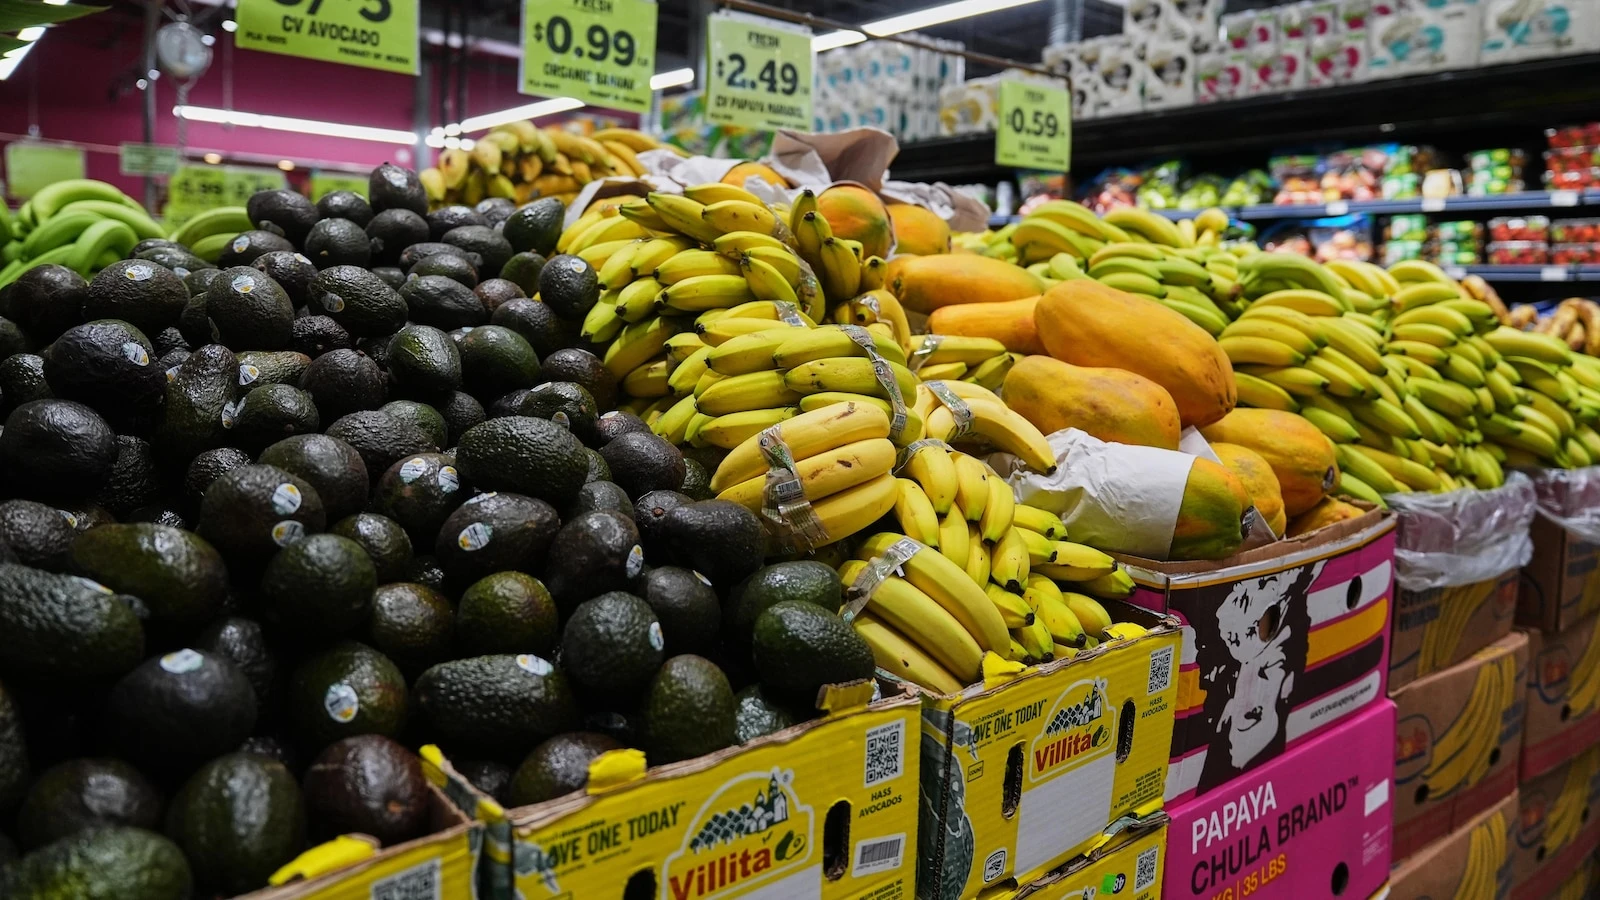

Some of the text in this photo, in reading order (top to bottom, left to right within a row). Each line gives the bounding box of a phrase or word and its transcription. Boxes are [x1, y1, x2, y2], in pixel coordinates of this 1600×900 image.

[281, 15, 380, 47] CV AVOCADO
[534, 16, 635, 67] $0.99
[747, 31, 779, 48] FRESH
[544, 62, 591, 83] ORGANIC
[717, 53, 798, 96] $2.49
[1141, 702, 1168, 719] AVOCADOS
[1150, 696, 1163, 707] HASS
[993, 712, 1013, 735] ONE
[1035, 732, 1092, 772] Villita
[859, 794, 903, 819] AVOCADOS
[870, 787, 892, 802] HASS
[1192, 780, 1277, 855] PAPAYA
[587, 823, 622, 855] ONE
[669, 848, 771, 900] Villita
[1191, 826, 1271, 896] CHULA
[1243, 871, 1258, 896] 35
[1262, 853, 1286, 885] LBS
